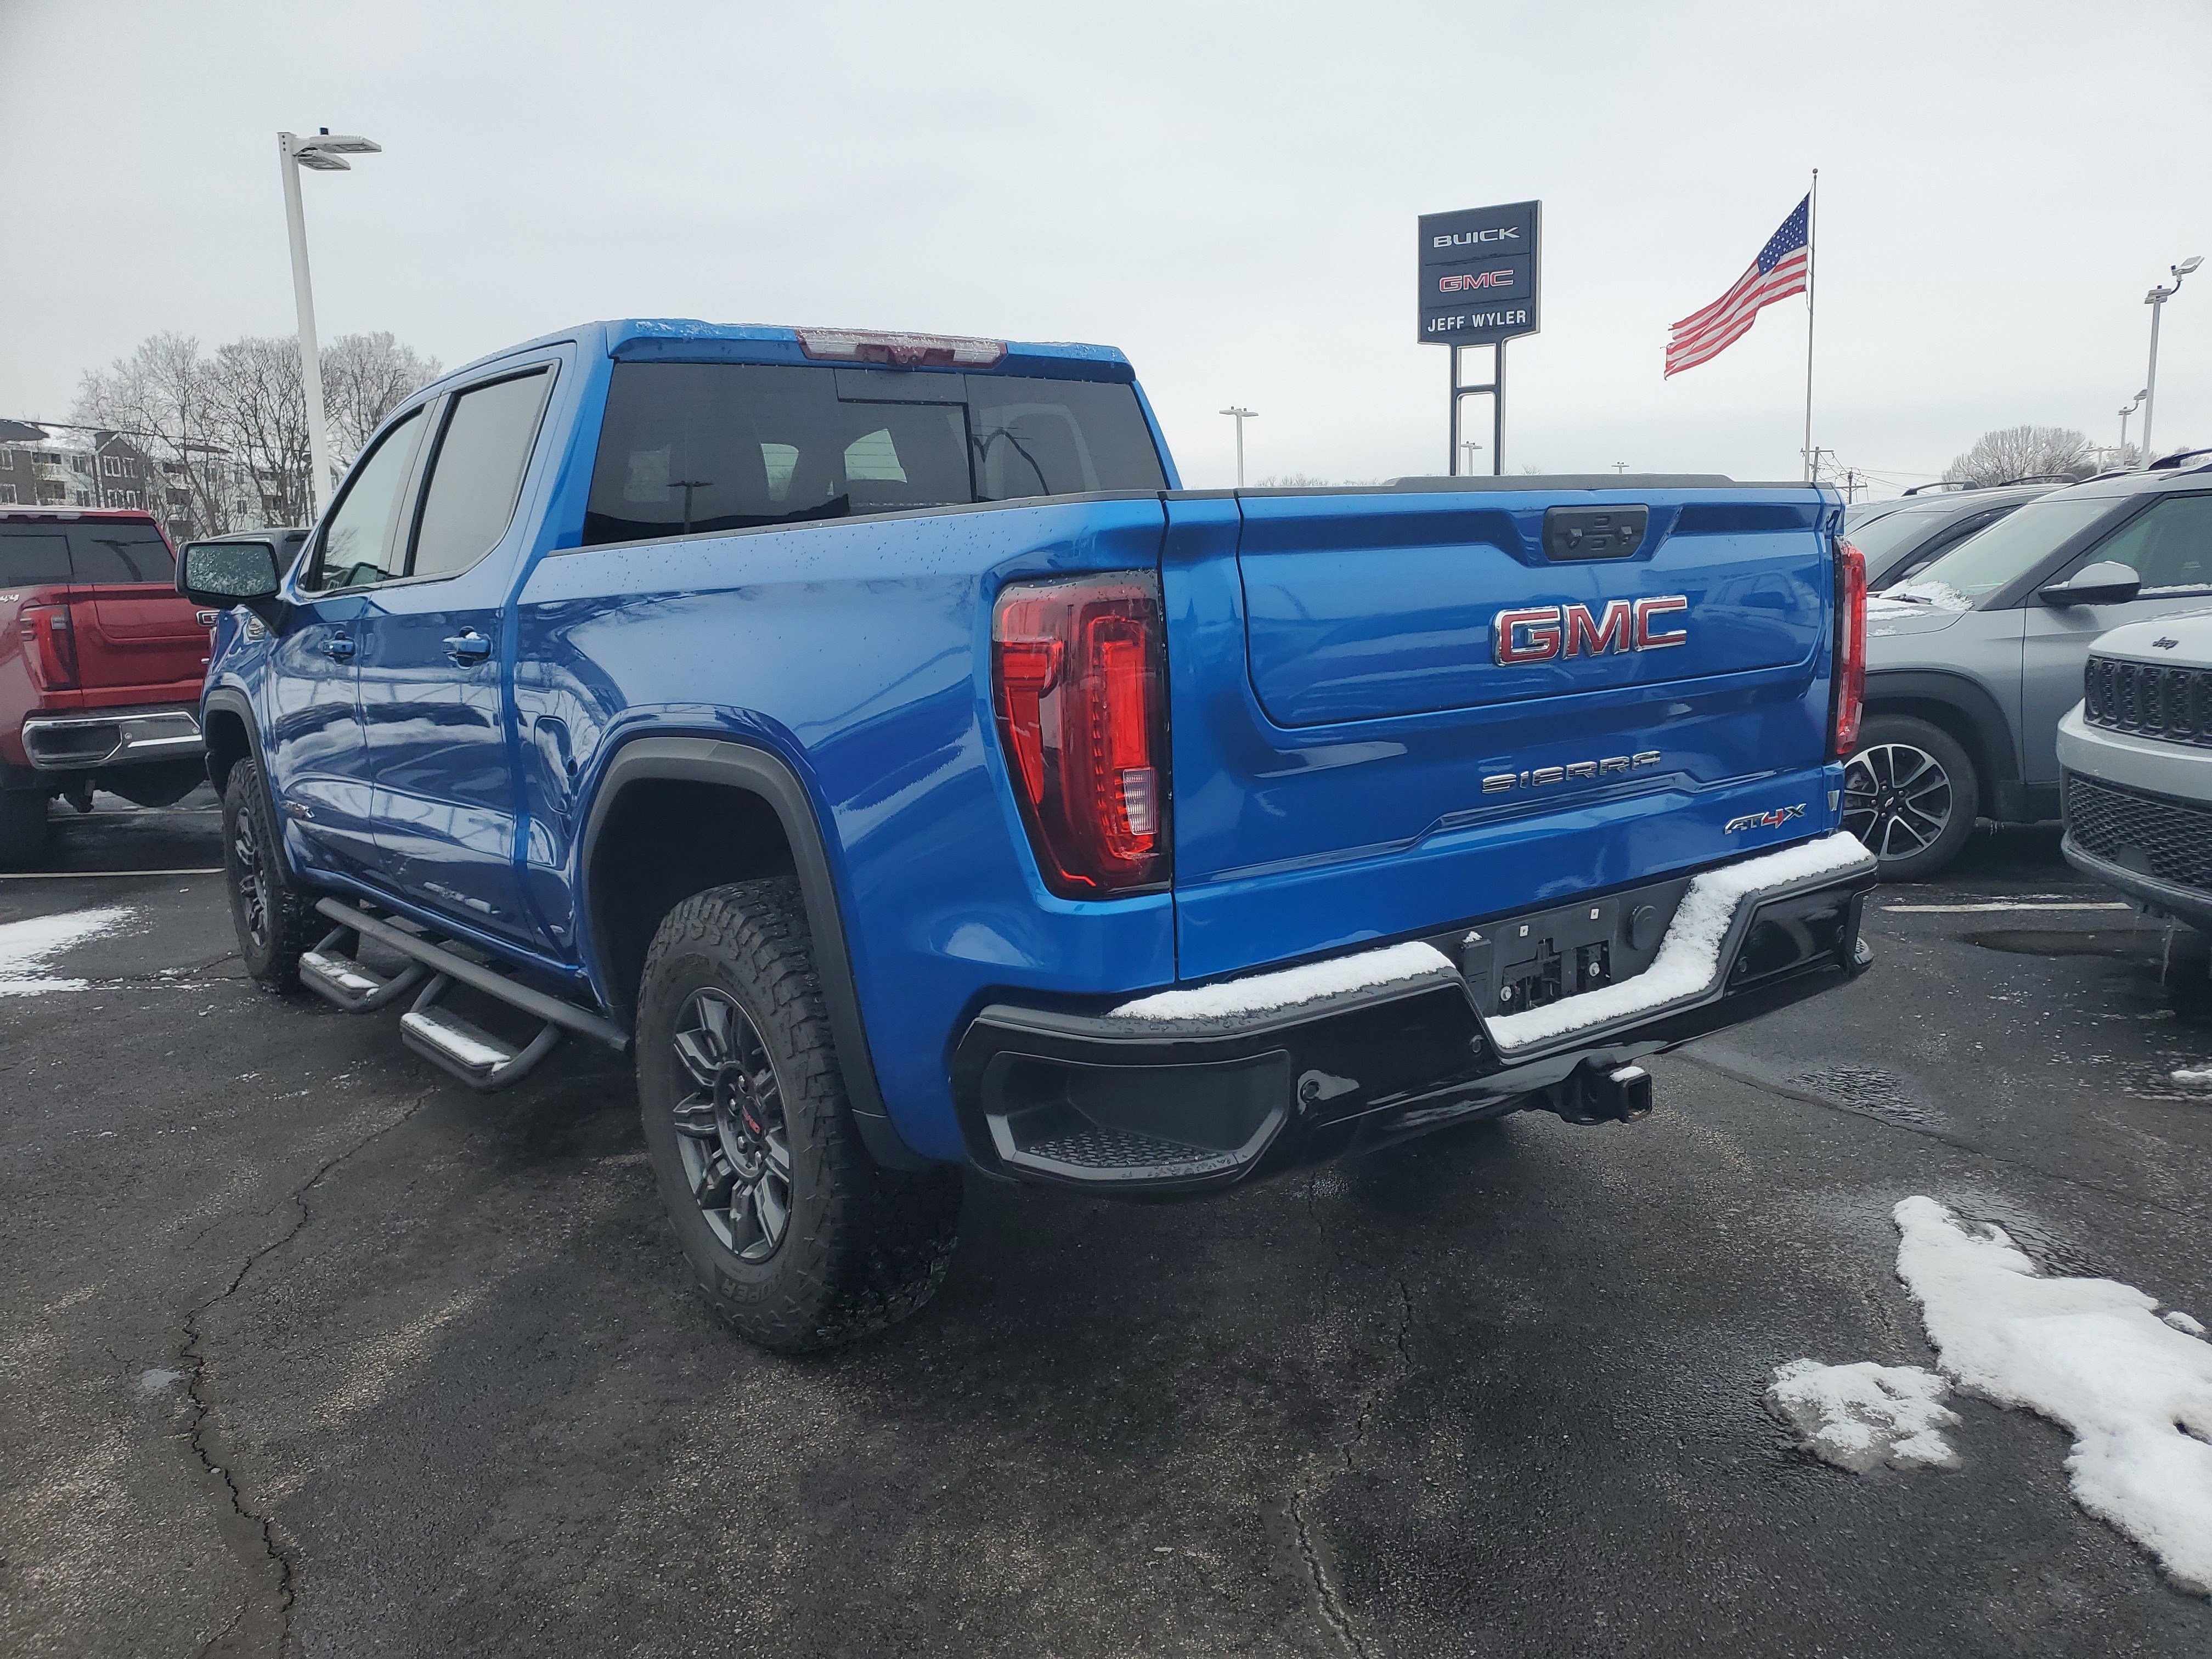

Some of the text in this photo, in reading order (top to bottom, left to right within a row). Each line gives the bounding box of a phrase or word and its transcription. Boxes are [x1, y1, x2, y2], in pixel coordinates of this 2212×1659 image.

[1433, 227, 1520, 248] BUICK
[1439, 269, 1514, 292] GMC
[1427, 309, 1526, 332] JEFF WYLER
[1494, 595, 1688, 667] GMC
[2152, 636, 2179, 651] Jeep
[1481, 750, 1661, 794] SIERRA
[1724, 803, 1807, 836] AT4X
